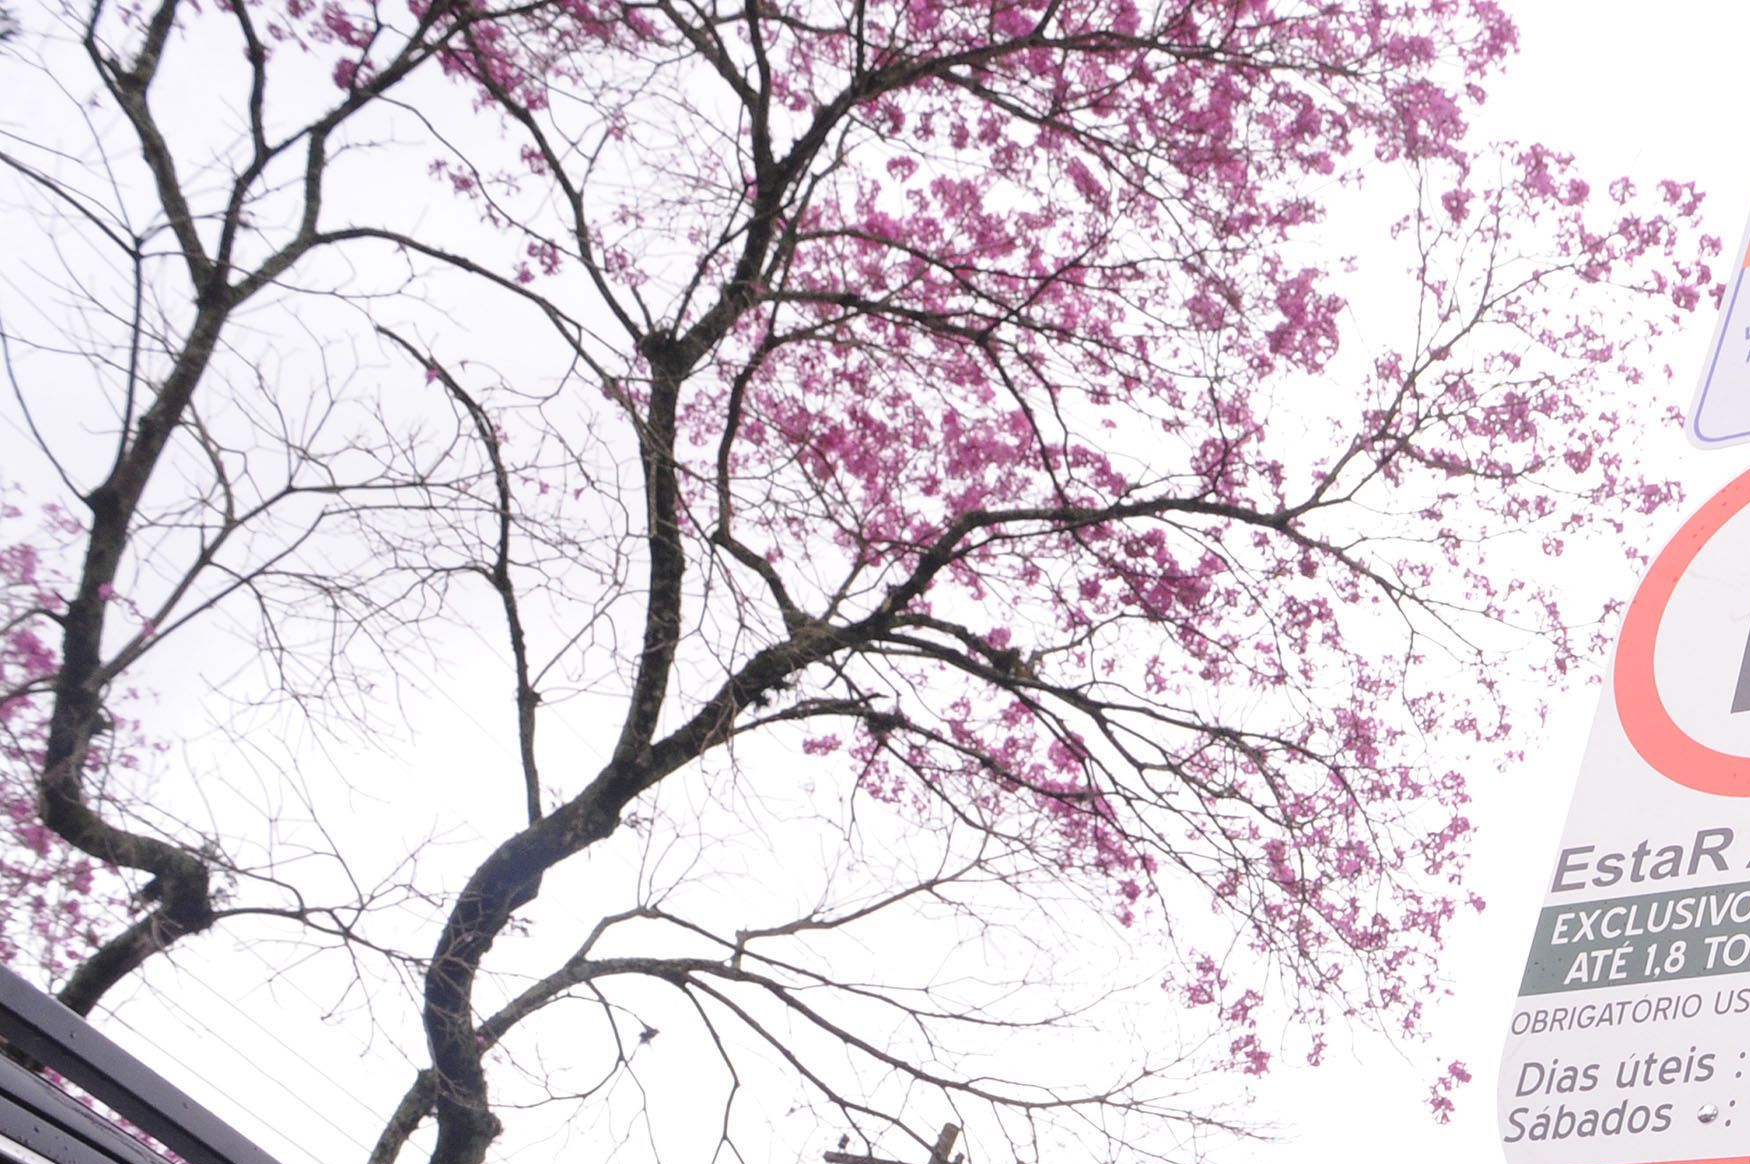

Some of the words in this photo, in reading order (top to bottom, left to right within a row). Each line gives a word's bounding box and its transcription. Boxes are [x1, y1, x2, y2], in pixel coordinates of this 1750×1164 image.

[1551, 826, 1736, 893] EstaR
[1563, 940, 1633, 985] ATÉ
[1645, 941, 1686, 980] 1,8
[1511, 993, 1702, 1036] OBRIGATÓRIO
[1516, 1060, 1599, 1098] Dias
[1616, 1047, 1715, 1088] úteis
[1503, 1099, 1673, 1144] Sábados
